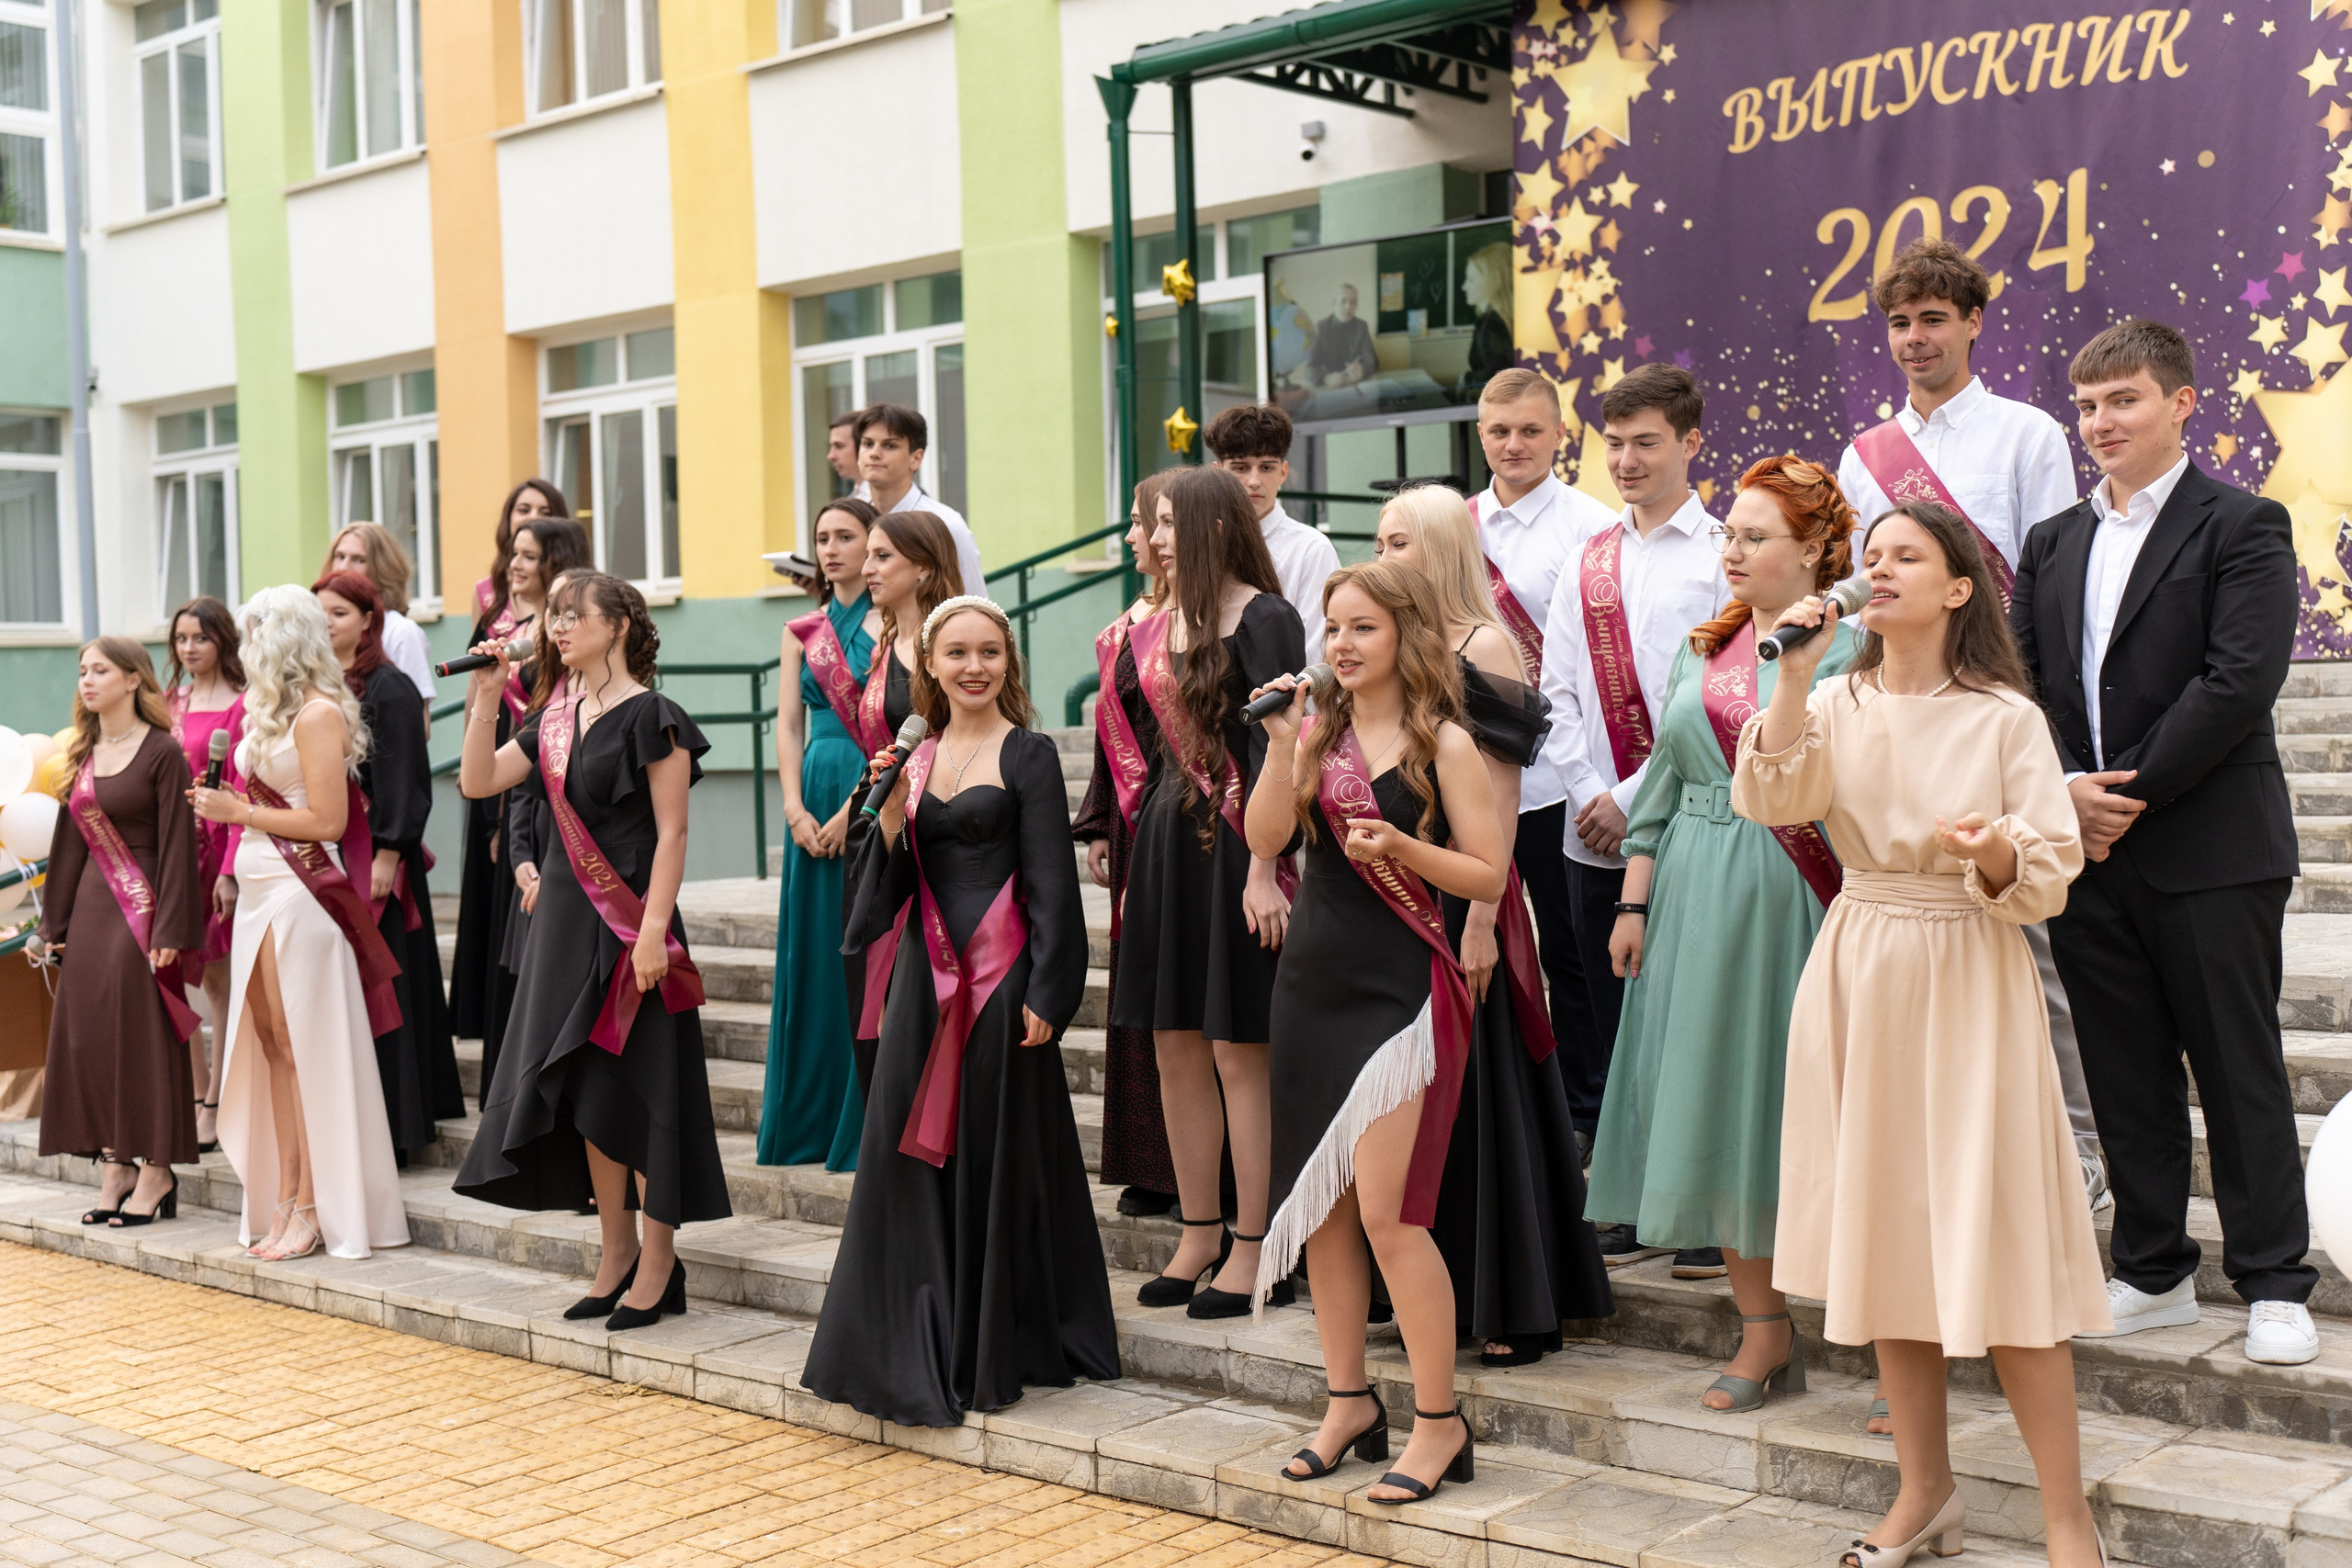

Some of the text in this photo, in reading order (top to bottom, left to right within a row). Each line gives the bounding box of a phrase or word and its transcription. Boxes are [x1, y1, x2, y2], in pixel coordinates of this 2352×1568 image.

[1722, 8, 2192, 155] ВЫПУСКНИК
[1588, 574, 1652, 761] Выпускник 2024
[1115, 747, 1146, 791] 2024
[577, 852, 619, 894] 2024
[123, 879, 154, 915] 2024
